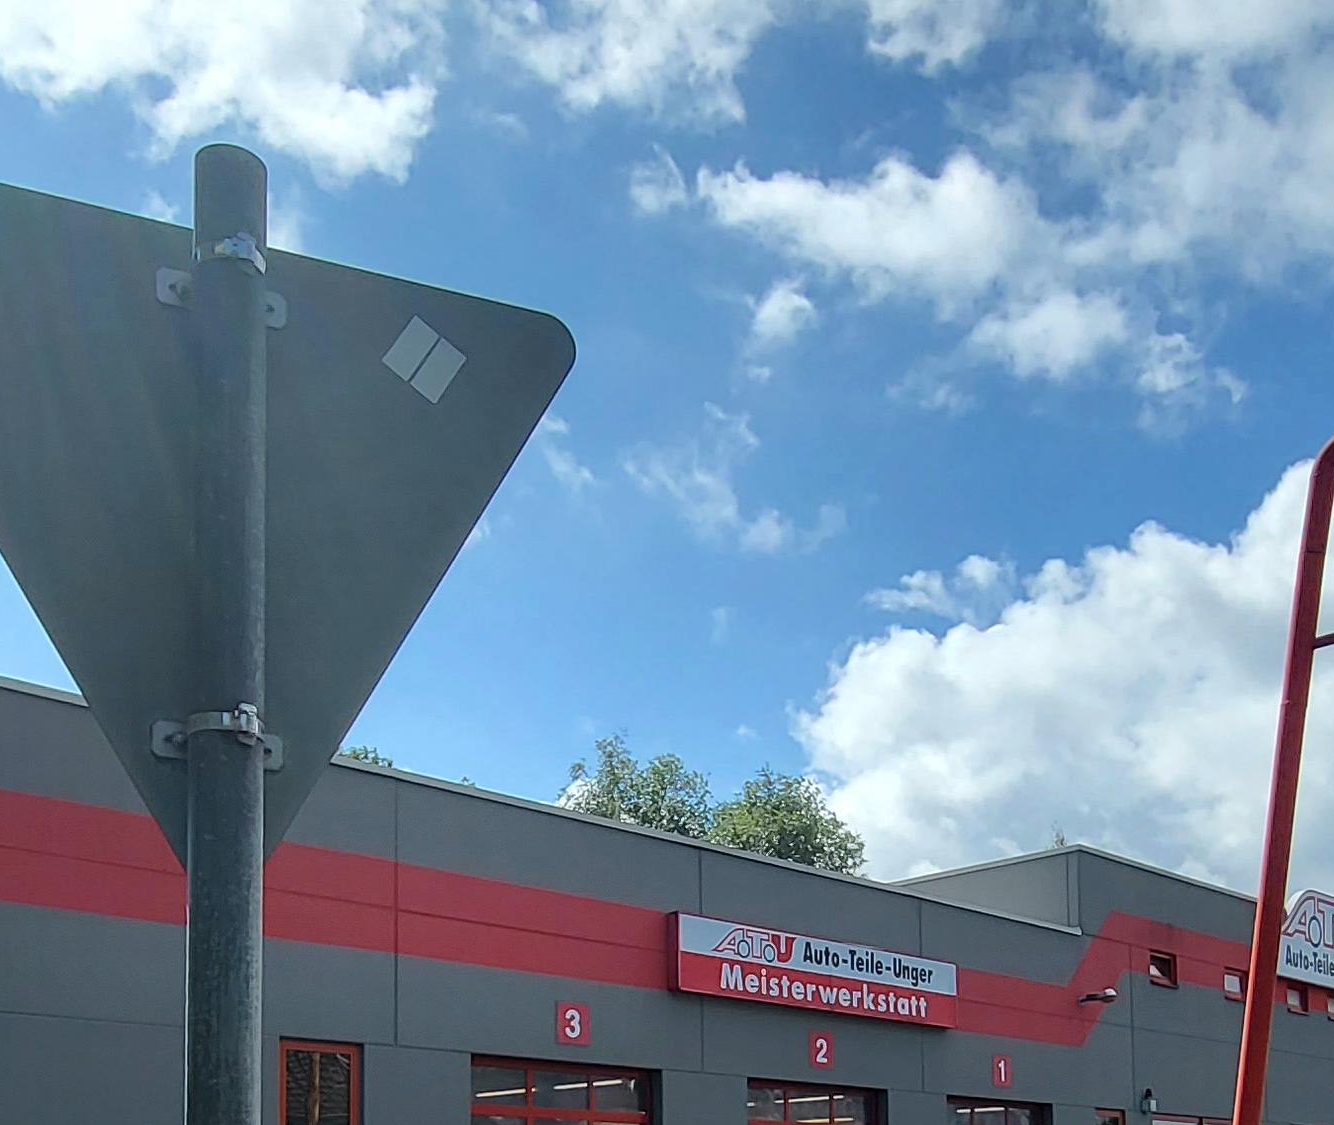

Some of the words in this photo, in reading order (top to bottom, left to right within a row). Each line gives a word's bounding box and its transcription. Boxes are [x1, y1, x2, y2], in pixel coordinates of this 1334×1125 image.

[802, 942, 933, 988] Auto-Teile-Unger
[719, 962, 928, 1019] Meisterwerkstatt
[564, 1008, 581, 1039] 3
[816, 1038, 828, 1064] 2
[998, 1059, 1007, 1082] 1
